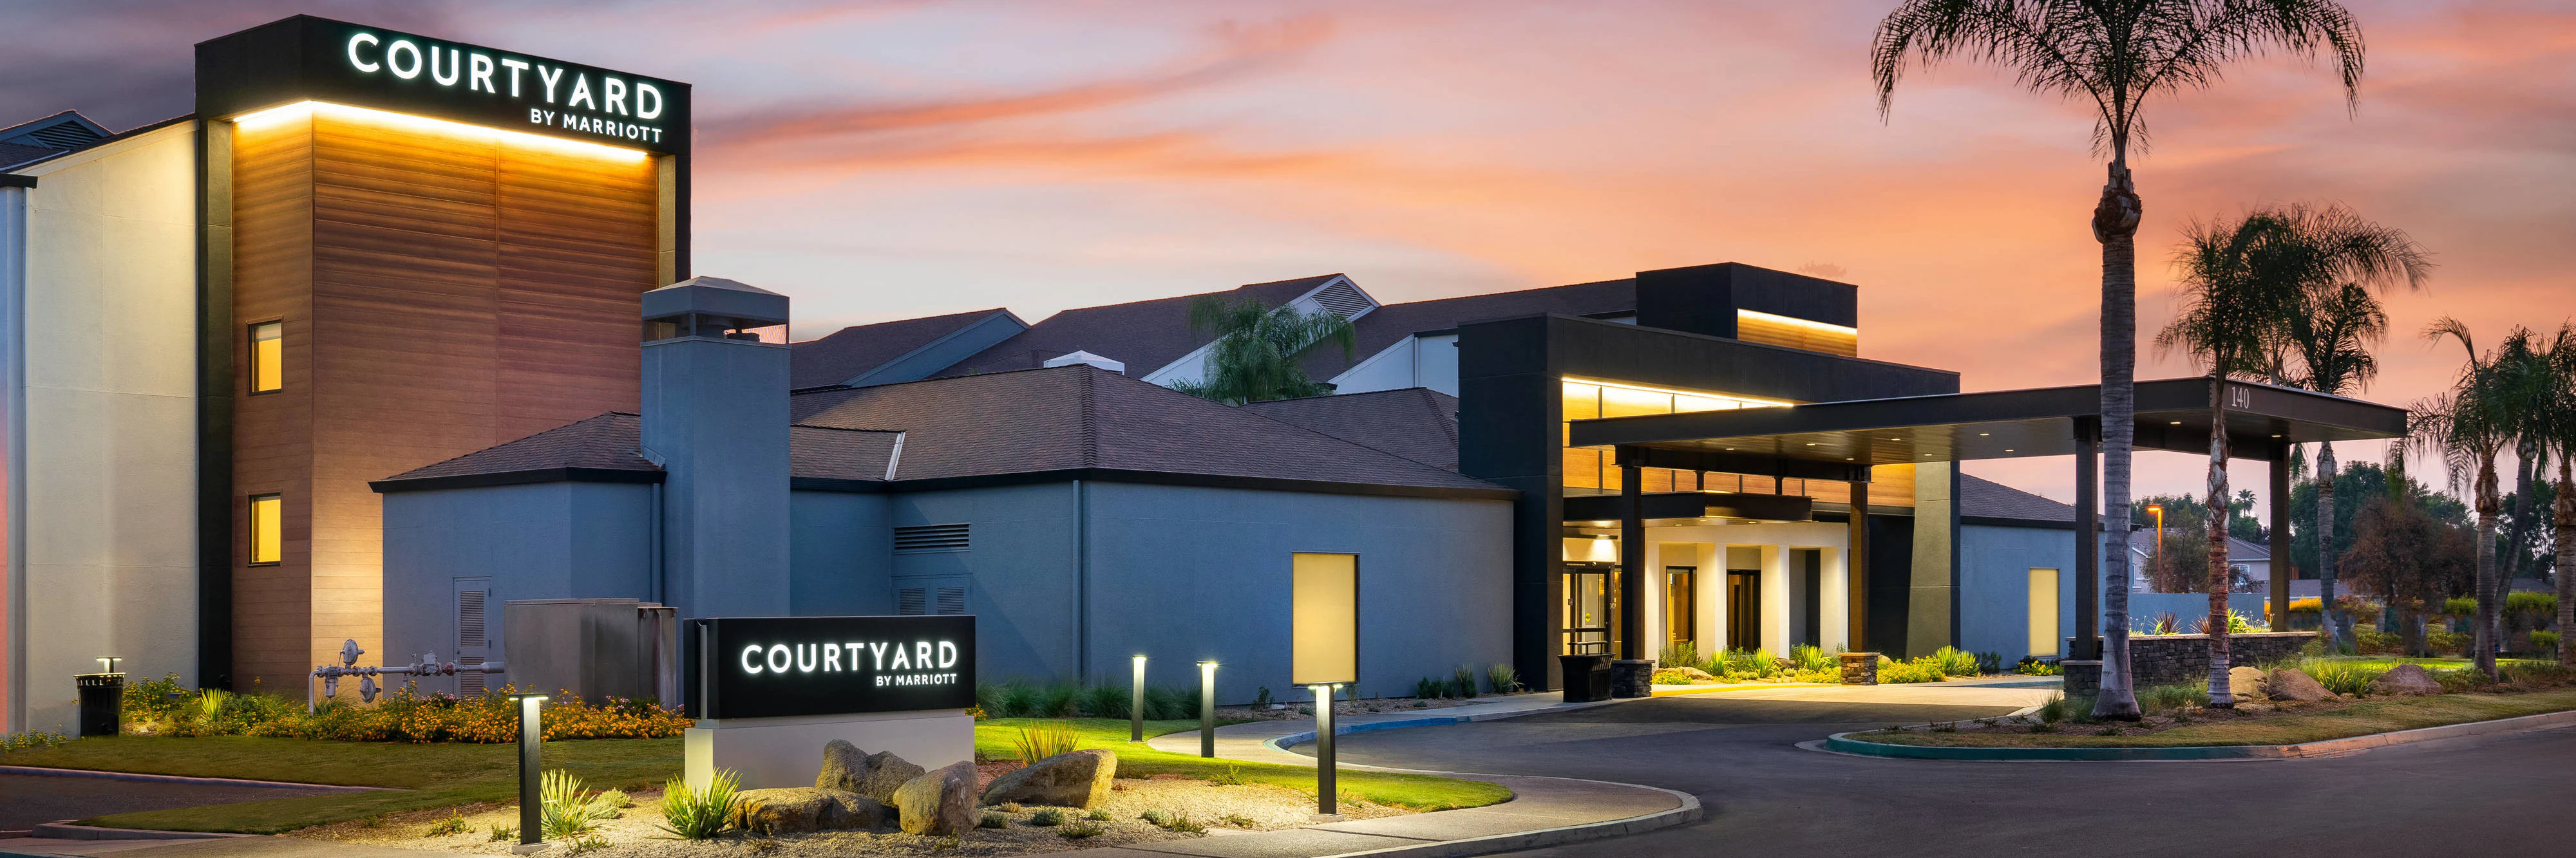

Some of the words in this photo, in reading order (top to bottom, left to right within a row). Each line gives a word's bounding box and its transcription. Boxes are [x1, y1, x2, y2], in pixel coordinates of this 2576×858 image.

[348, 33, 663, 120] COURTYARD
[531, 107, 555, 126] BY
[564, 113, 662, 143] MARRIOTT
[2231, 386, 2249, 409] 140
[741, 640, 957, 674] COURTYARD
[876, 675, 891, 686] BY
[896, 673, 957, 685] MARRIOTT
